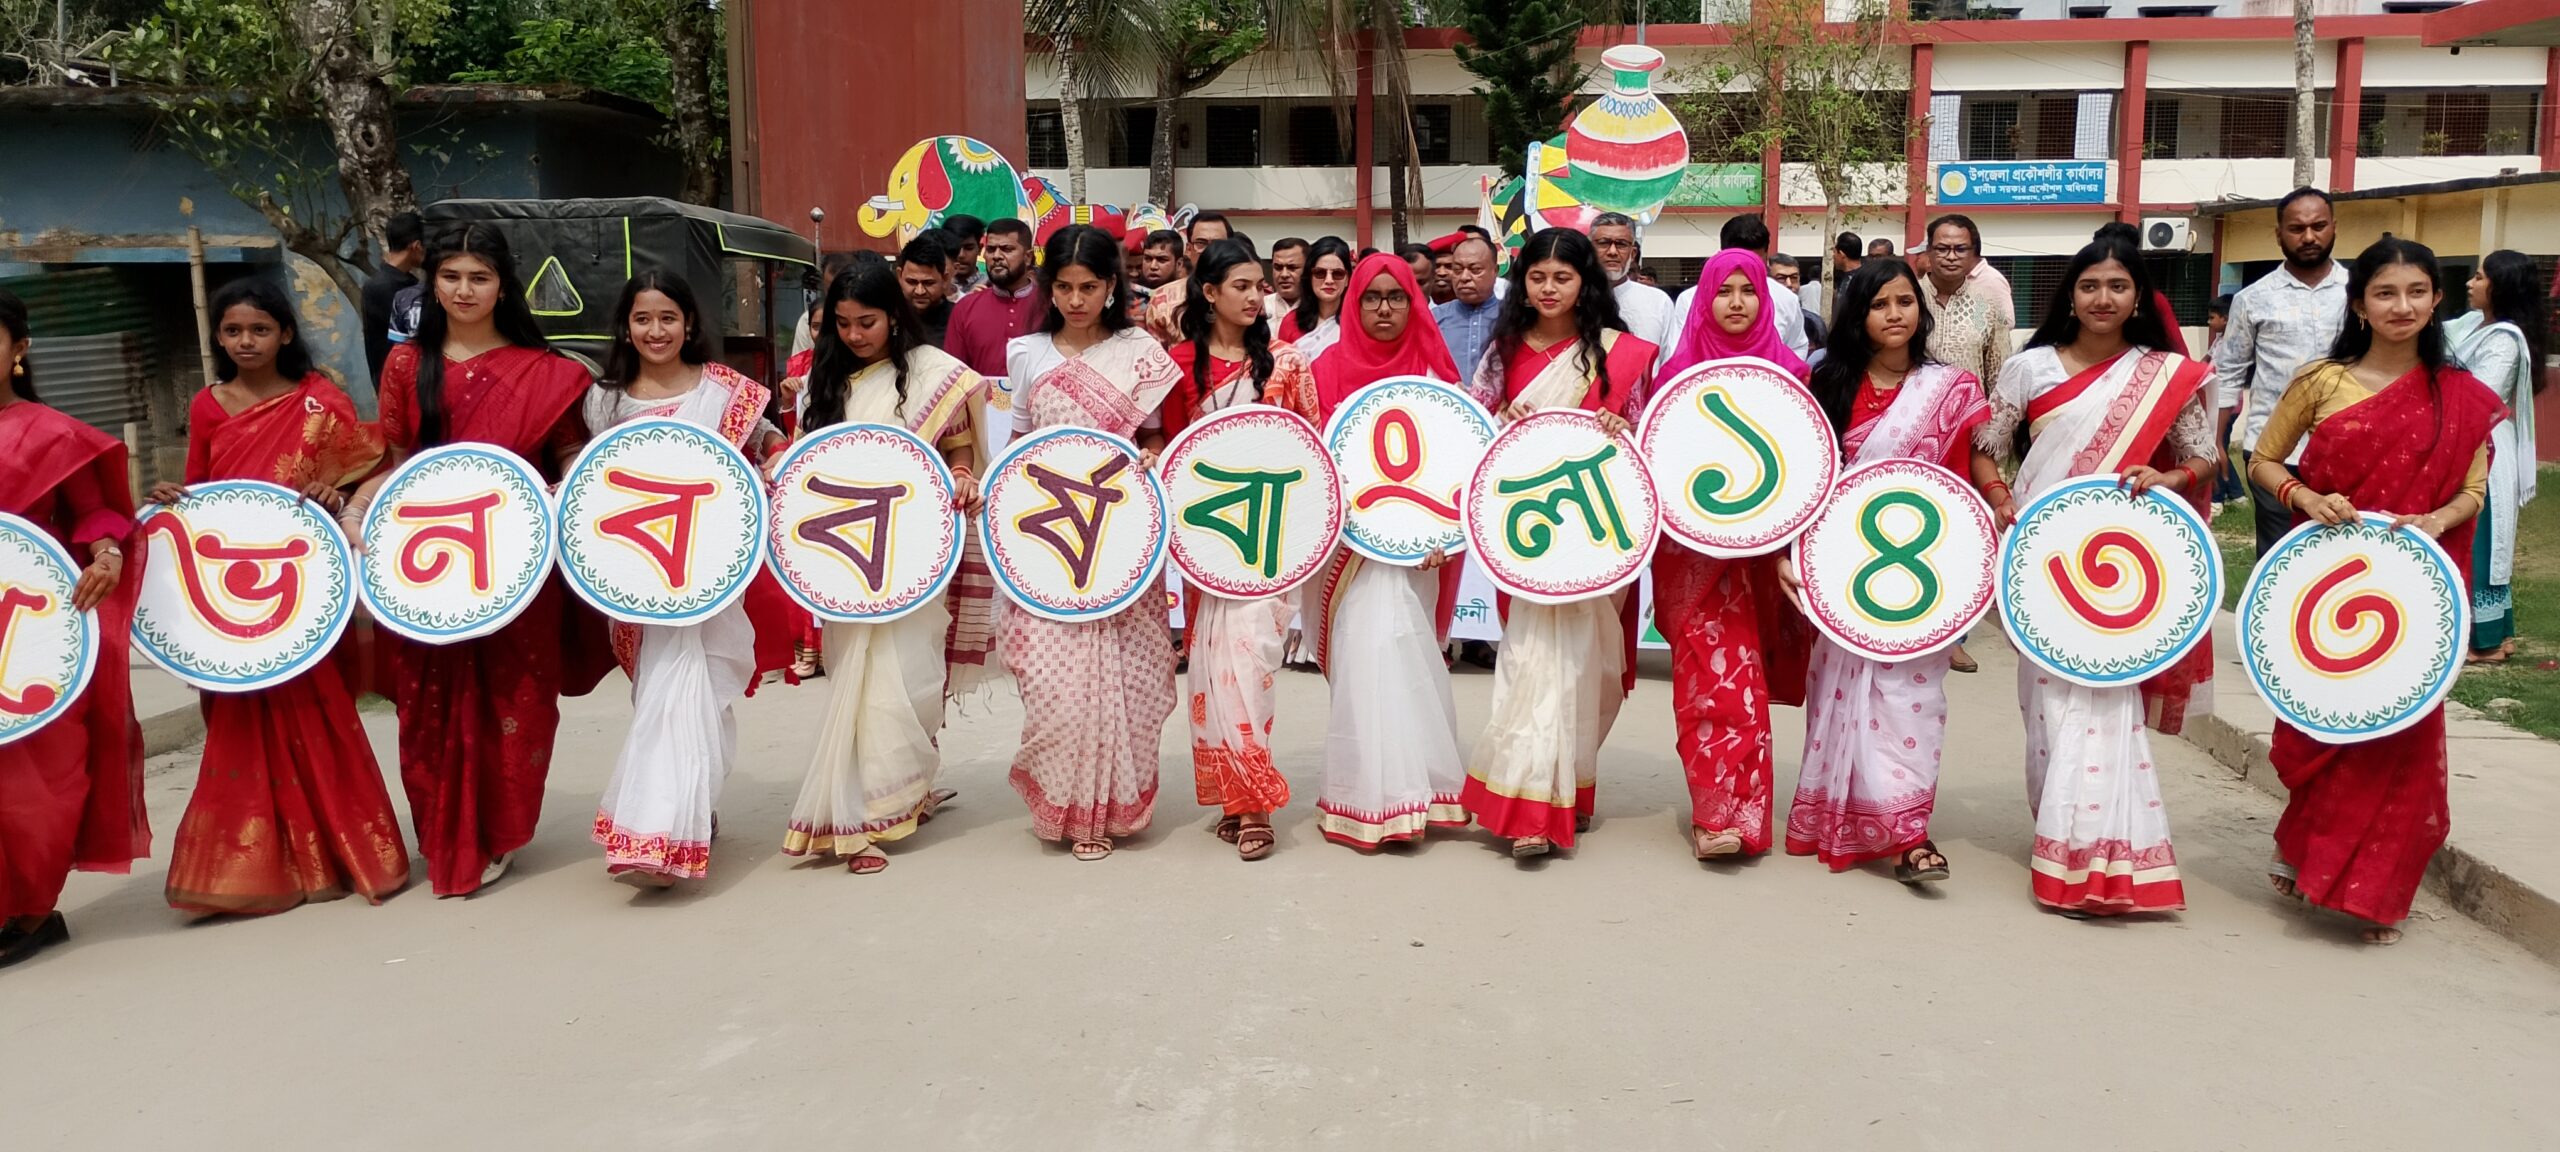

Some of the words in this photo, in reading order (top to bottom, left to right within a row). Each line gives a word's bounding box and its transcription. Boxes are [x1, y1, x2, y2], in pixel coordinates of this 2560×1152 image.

[1969, 167, 2009, 181] উপজেলা
[2012, 164, 2063, 181] প্রকৌশলীর
[2065, 163, 2104, 181] কার্যালয়
[1973, 183, 1996, 194] স্থানীয়
[1999, 185, 2026, 193] সরকার
[2028, 183, 2062, 193] প্রকৌশল
[2065, 182, 2098, 192] অধিদপ্তর
[1690, 391, 1778, 517] ১
[1852, 489, 1942, 623] ৪
